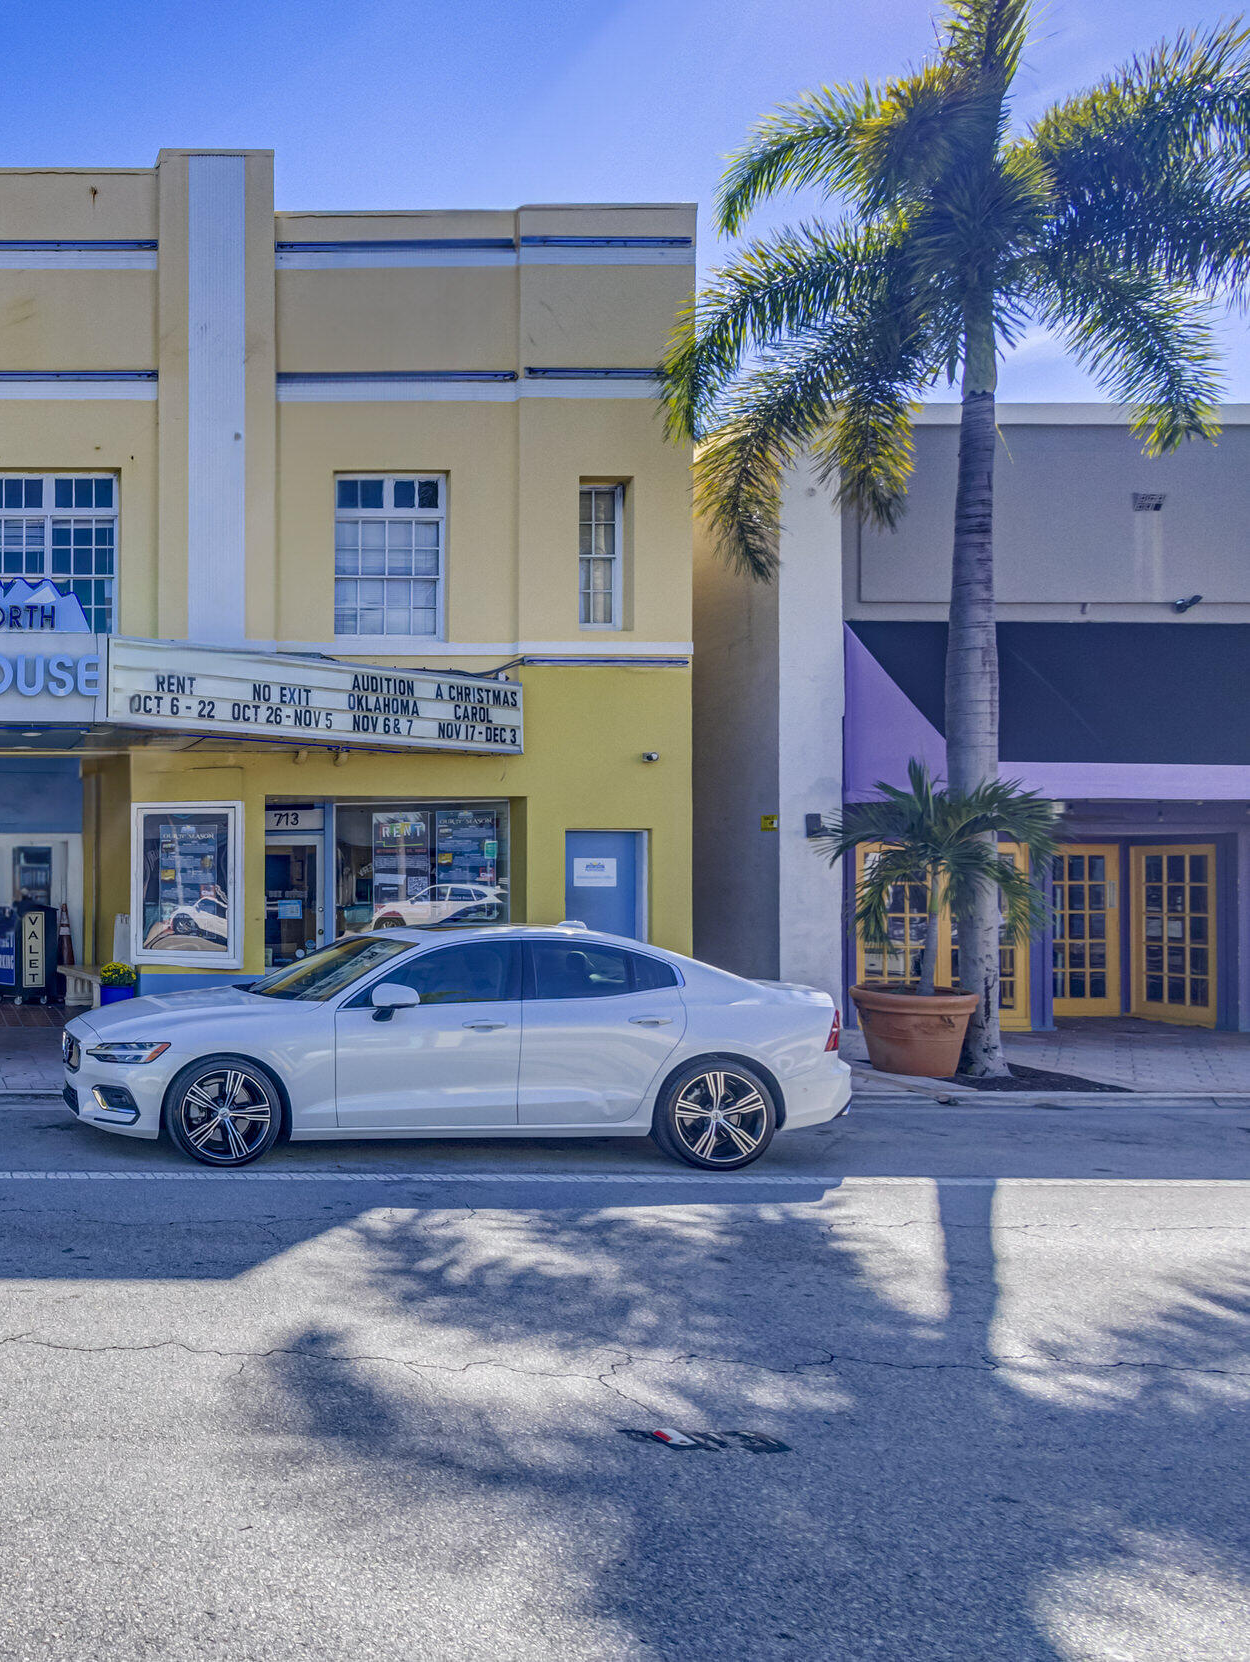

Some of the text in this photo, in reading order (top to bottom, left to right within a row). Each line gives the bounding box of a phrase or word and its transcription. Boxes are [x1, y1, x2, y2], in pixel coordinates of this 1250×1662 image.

[156, 674, 196, 695] RENT
[253, 683, 312, 706] NO EXIT
[352, 674, 414, 697] AUDITION
[435, 683, 517, 707] A CHRISTMAS
[129, 693, 163, 714] OCT
[231, 702, 260, 722] OCT
[348, 693, 420, 717] OKLAHOMA
[454, 704, 493, 724] CAROL
[352, 714, 378, 733] NOV
[406, 719, 413, 735] 7
[438, 722, 461, 739] NOV
[510, 729, 517, 744] 3
[274, 812, 299, 826] 713
[382, 825, 422, 837] RENT
[28, 916, 39, 983] VALET
